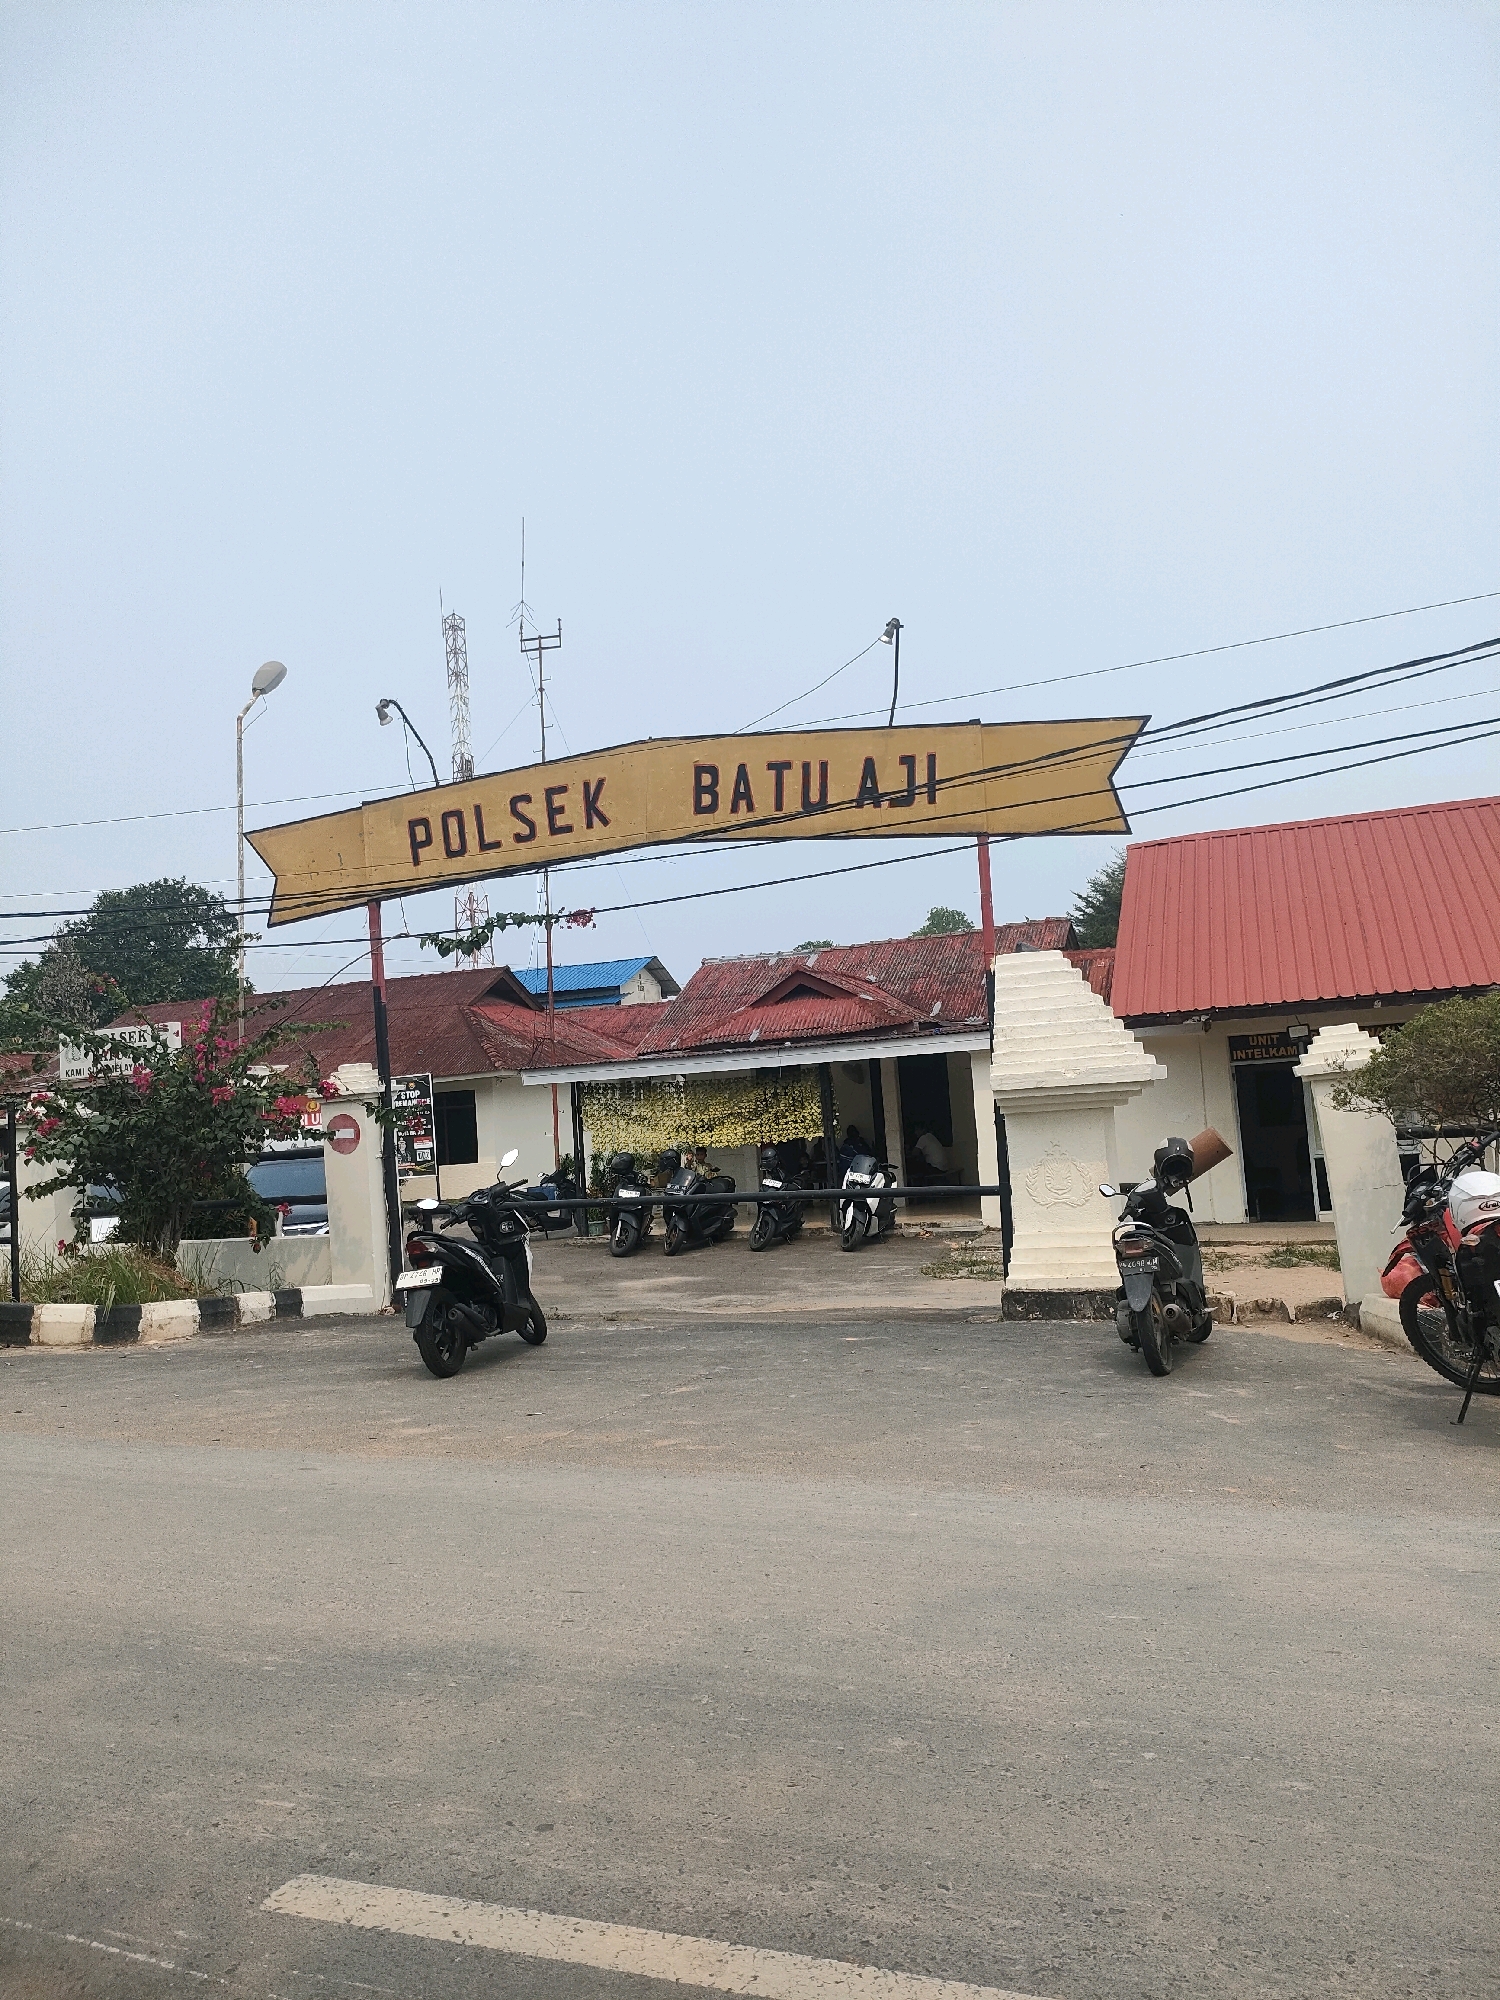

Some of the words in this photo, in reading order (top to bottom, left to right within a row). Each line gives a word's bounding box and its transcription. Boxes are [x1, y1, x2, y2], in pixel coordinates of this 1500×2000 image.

[407, 777, 612, 867] POLSEK
[692, 760, 830, 816] BATU
[854, 752, 938, 810] AJI
[1249, 1034, 1280, 1046] UNIT
[1233, 1045, 1298, 1060] INTELKAM
[65, 1068, 85, 1077] KAMI
[400, 1089, 420, 1100] STOP
